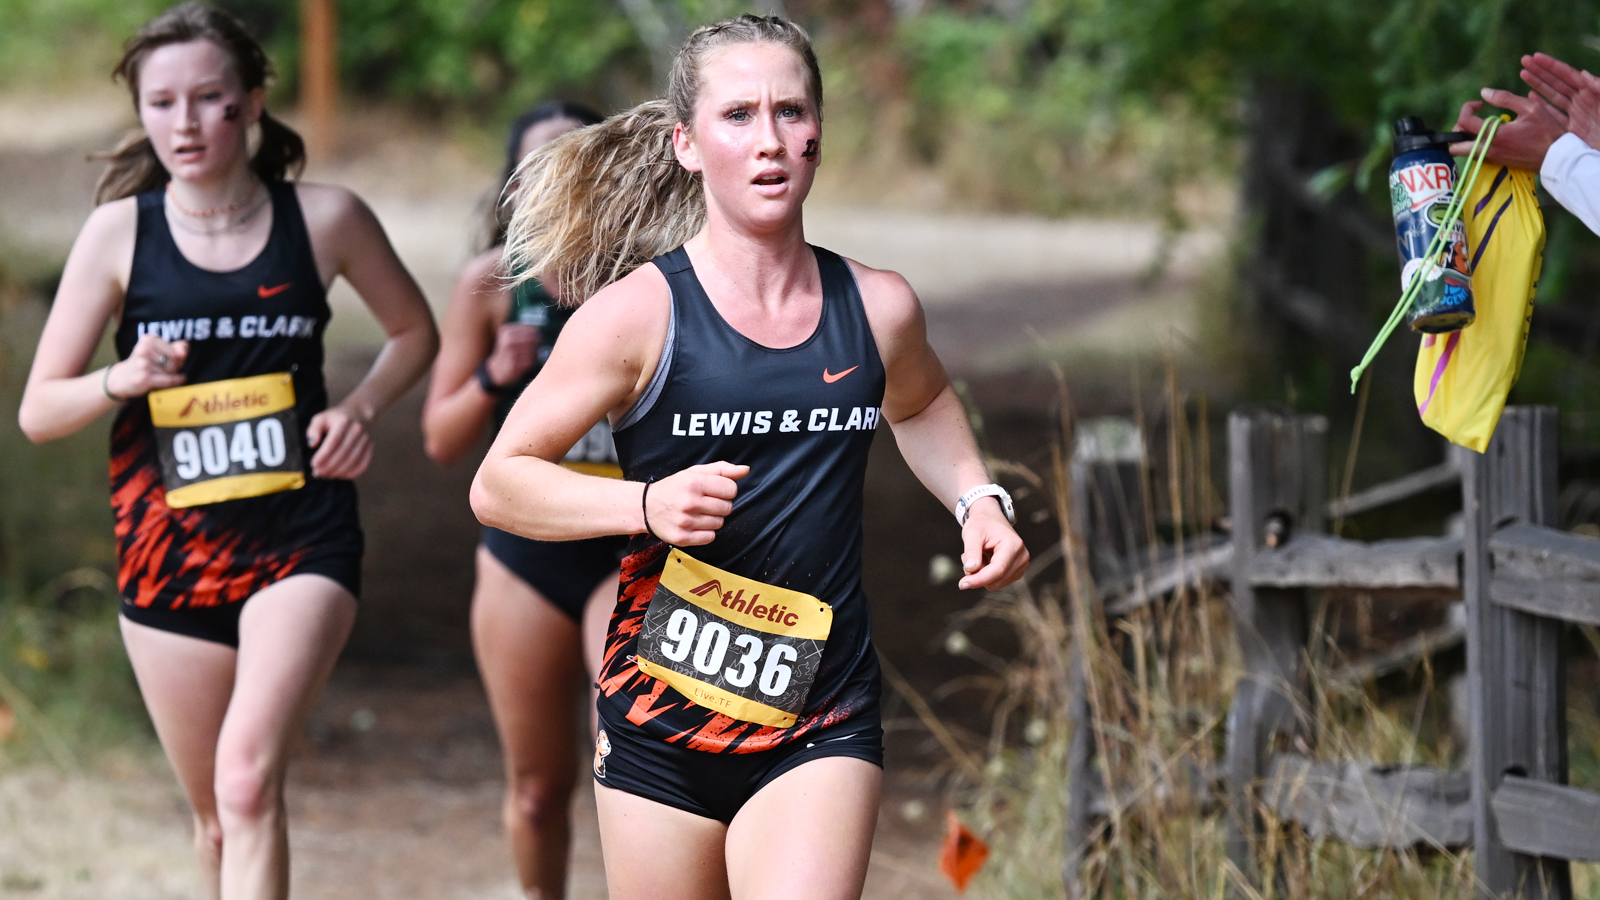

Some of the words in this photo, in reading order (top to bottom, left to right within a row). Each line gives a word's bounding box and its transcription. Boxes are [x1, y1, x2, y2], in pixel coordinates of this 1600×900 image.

[1399, 165, 1452, 193] NXR
[137, 317, 212, 341] LEWIS
[215, 316, 235, 338] &
[672, 410, 773, 436] LEWIS
[779, 409, 802, 432] &
[172, 417, 287, 480] 9040
[689, 579, 799, 627] Athletic
[660, 608, 798, 697] 9036
[693, 687, 732, 708] Live.TF
